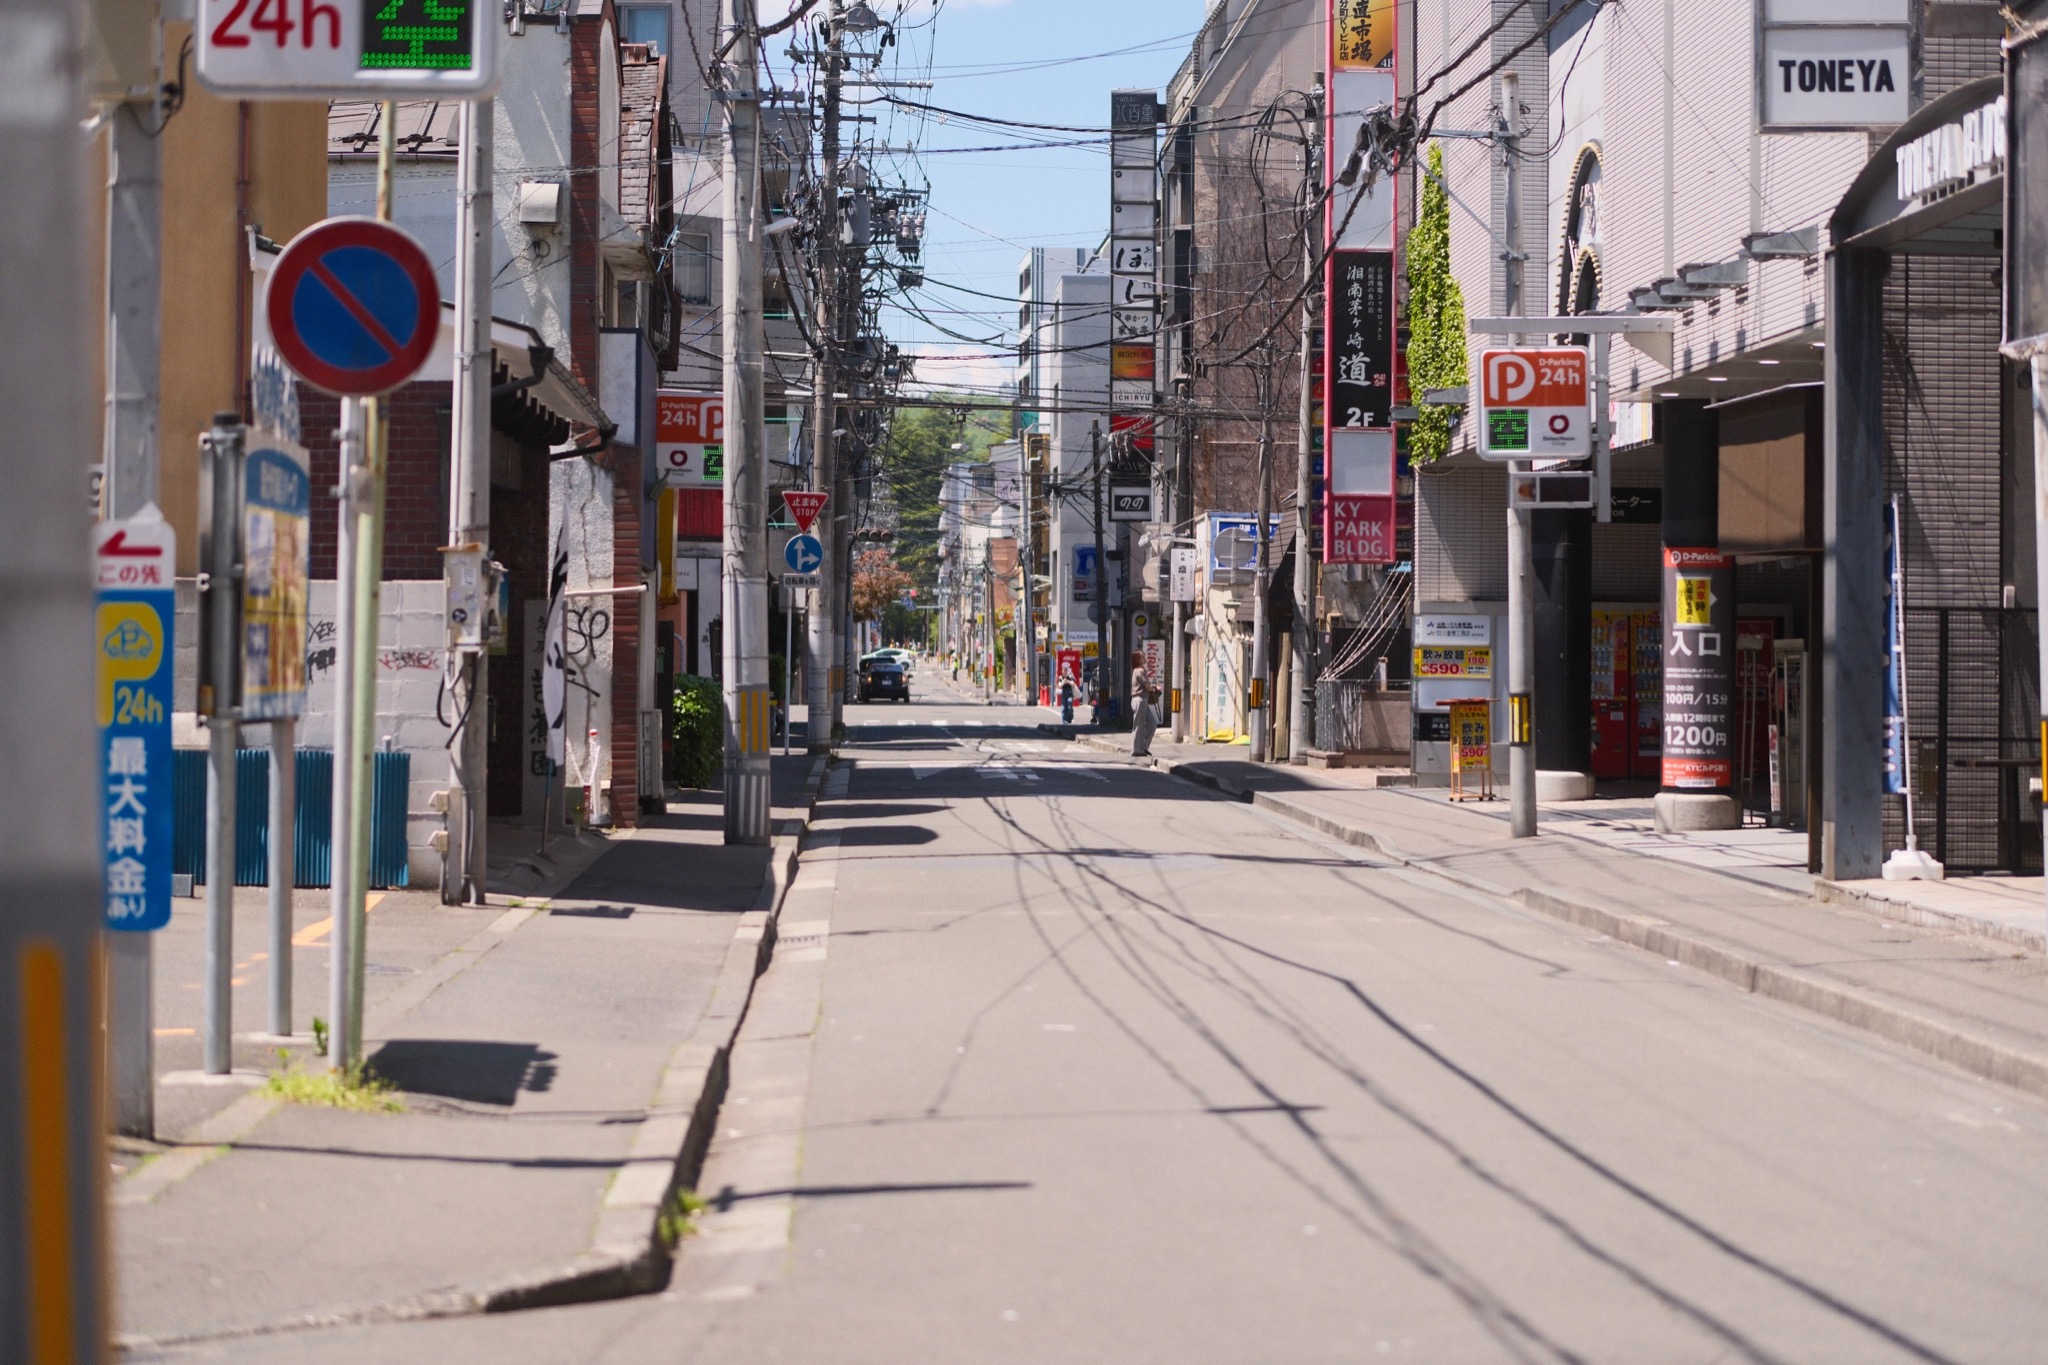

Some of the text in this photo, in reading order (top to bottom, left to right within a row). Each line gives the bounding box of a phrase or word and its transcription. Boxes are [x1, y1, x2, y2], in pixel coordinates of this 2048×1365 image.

[211, 0, 341, 48] 24h
[1778, 60, 1895, 92] TONEYA
[1896, 122, 1967, 200] TONEYA
[1538, 358, 1581, 368] D-Parking
[1540, 369, 1581, 386] 24h
[661, 402, 698, 411] D-Parking
[661, 410, 697, 426] 24h
[1346, 407, 1374, 427] 2F
[1488, 408, 1529, 450] 空
[792, 497, 819, 507] 止まれ
[1334, 502, 1360, 517] KY
[796, 508, 815, 516] STOP
[1334, 521, 1383, 537] PARK
[1334, 540, 1389, 556] BLDG.
[98, 565, 161, 584] この先
[1670, 630, 1720, 656] 入口
[117, 686, 163, 725] 24h
[1665, 726, 1727, 747] 1200円
[107, 737, 147, 919] 最大料金あり
